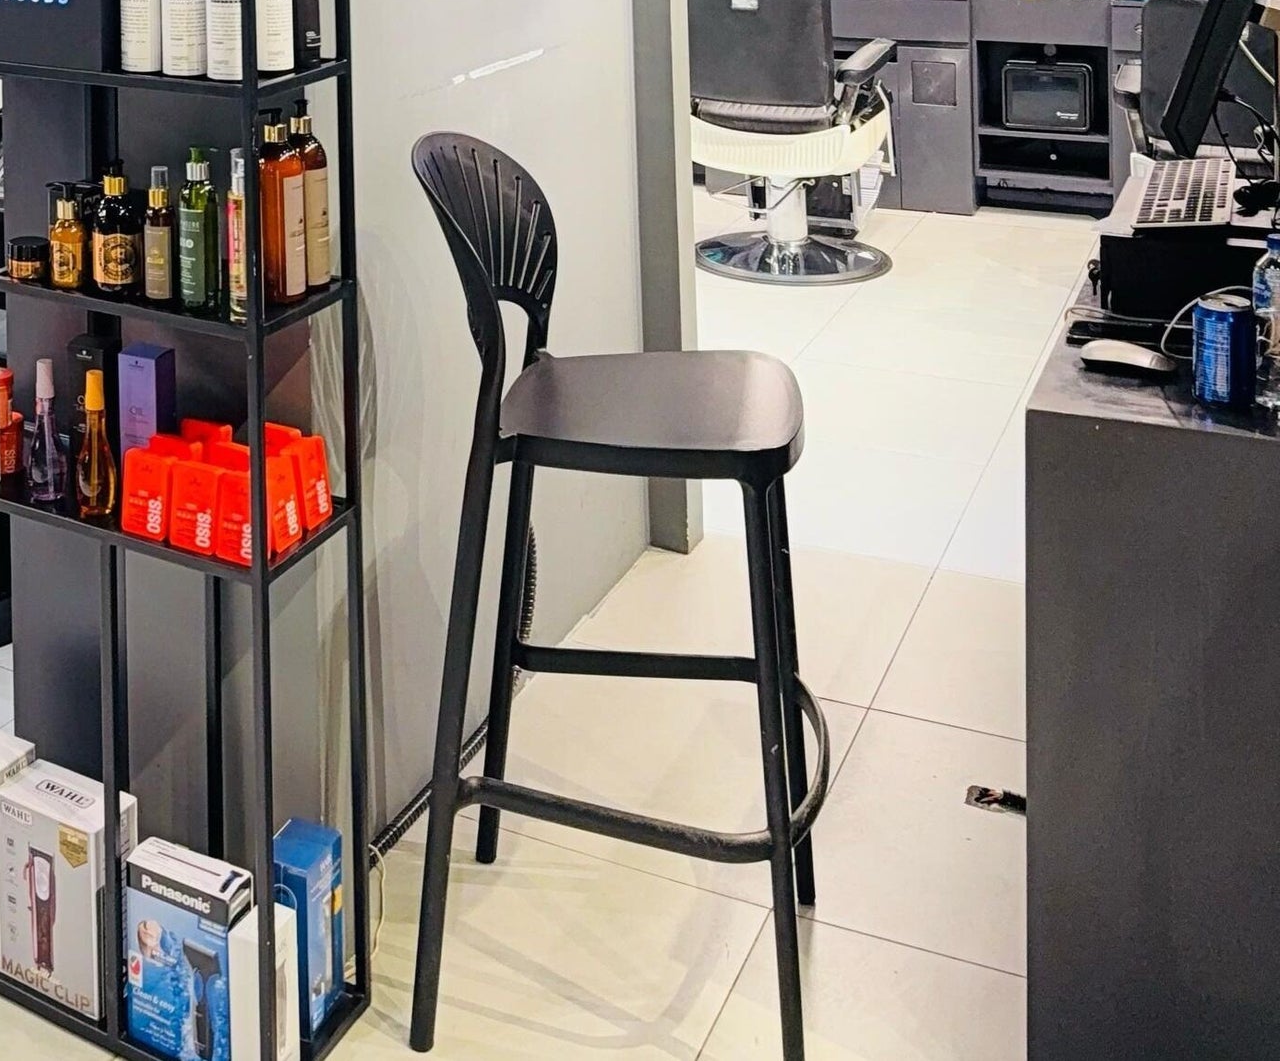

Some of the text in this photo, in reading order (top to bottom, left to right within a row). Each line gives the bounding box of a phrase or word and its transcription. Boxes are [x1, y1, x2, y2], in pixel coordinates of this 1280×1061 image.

[45, 781, 90, 807] WAHL
[3, 803, 31, 823] WAHL
[141, 874, 212, 914] Panasonic
[1, 956, 50, 992] MAGIC
[54, 984, 91, 1011] CLIP
